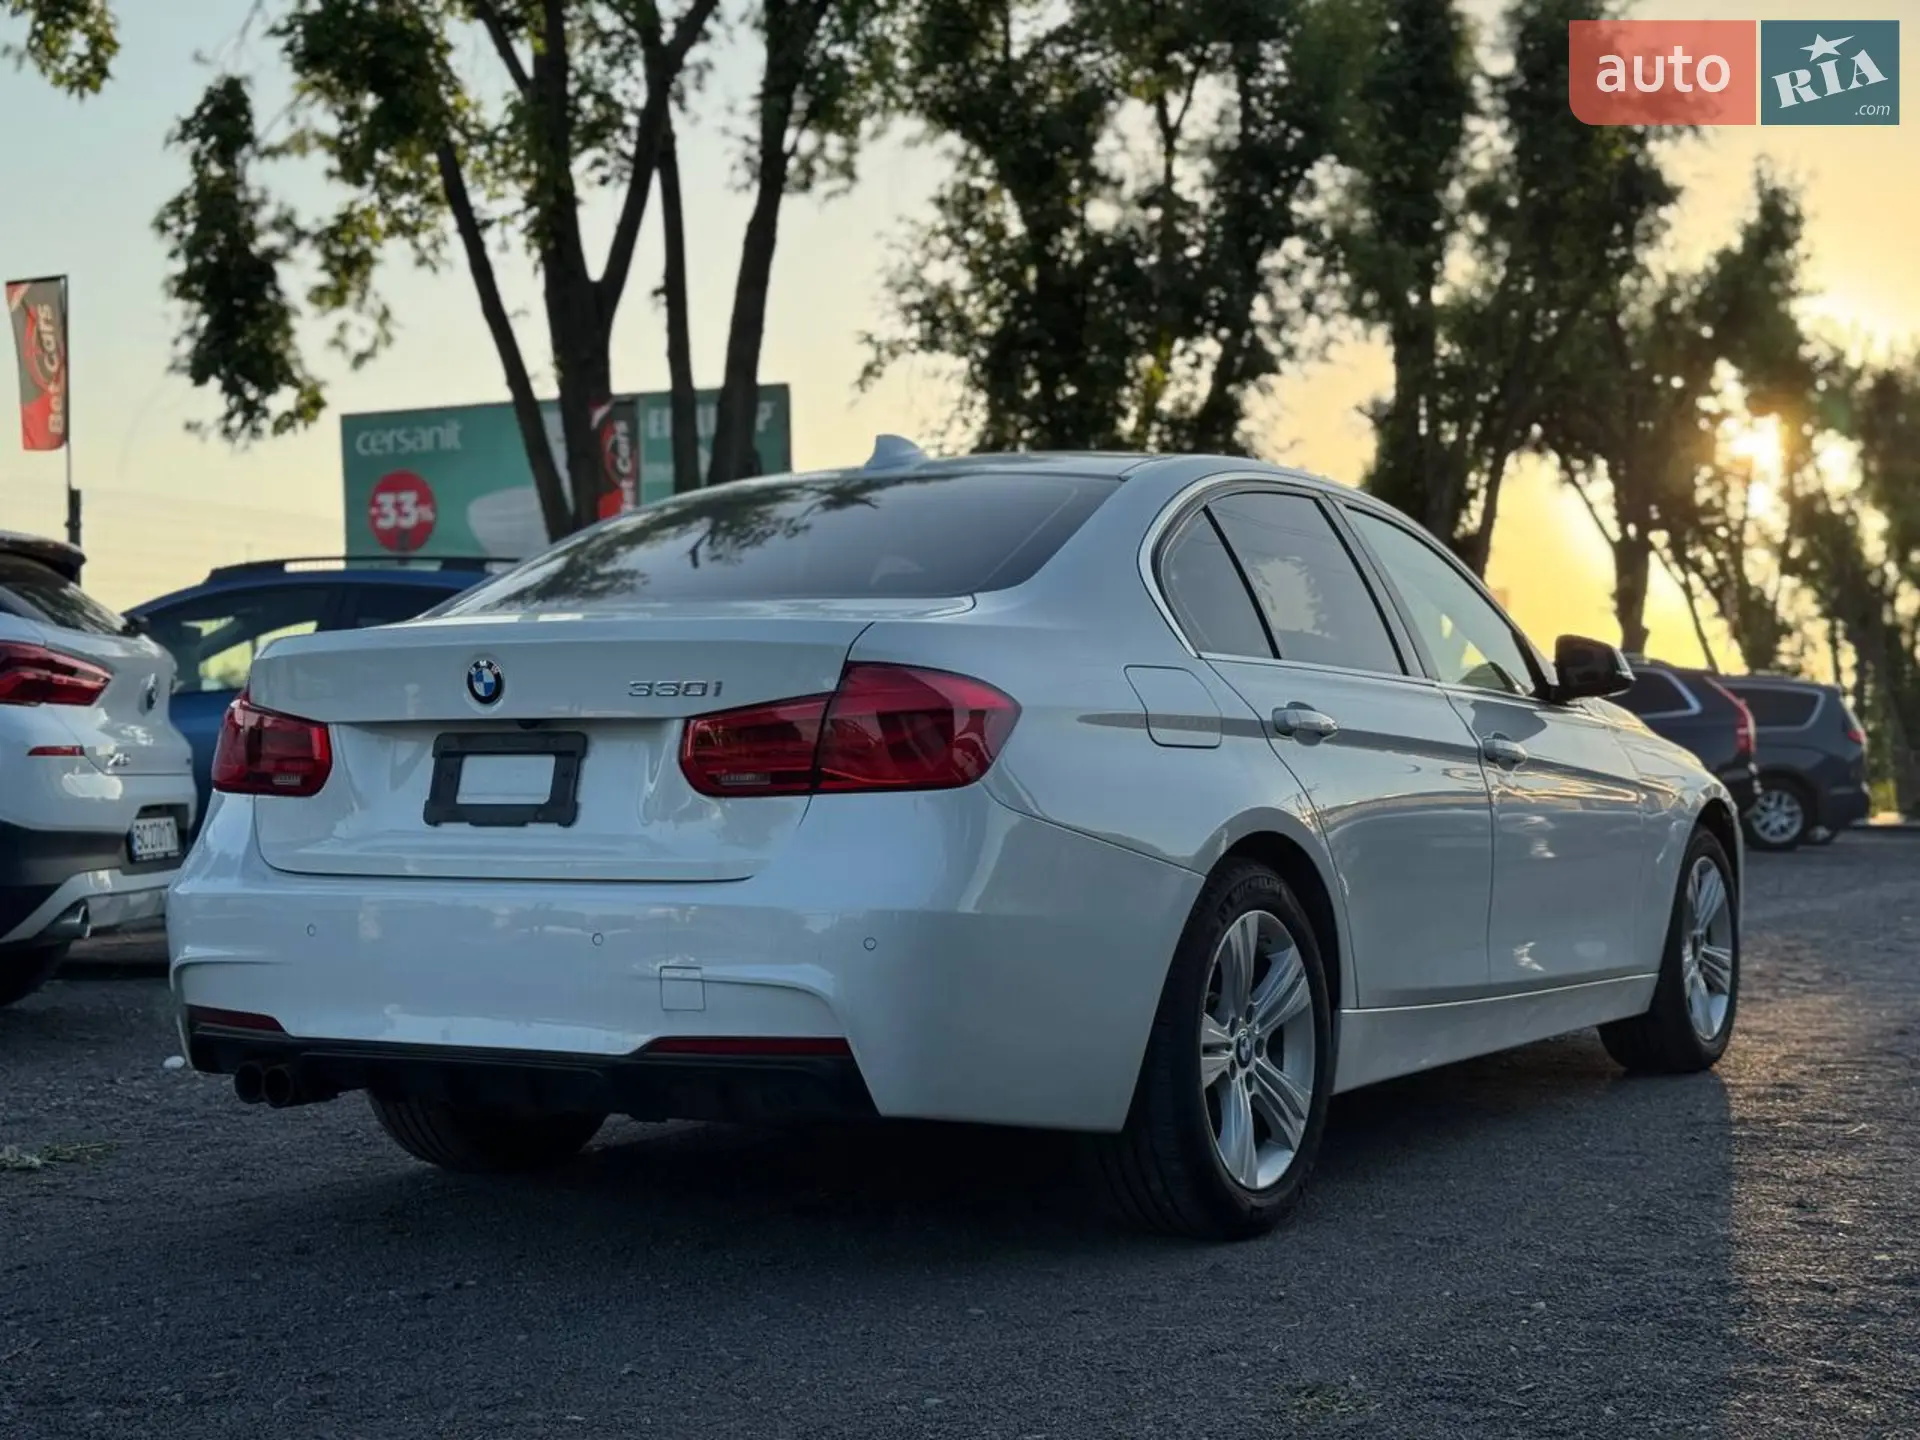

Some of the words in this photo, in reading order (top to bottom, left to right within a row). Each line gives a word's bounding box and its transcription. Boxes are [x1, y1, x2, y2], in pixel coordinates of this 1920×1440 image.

[37, 303, 60, 373] Cars
[355, 418, 463, 457] cersanit
[628, 680, 723, 698] 330i
